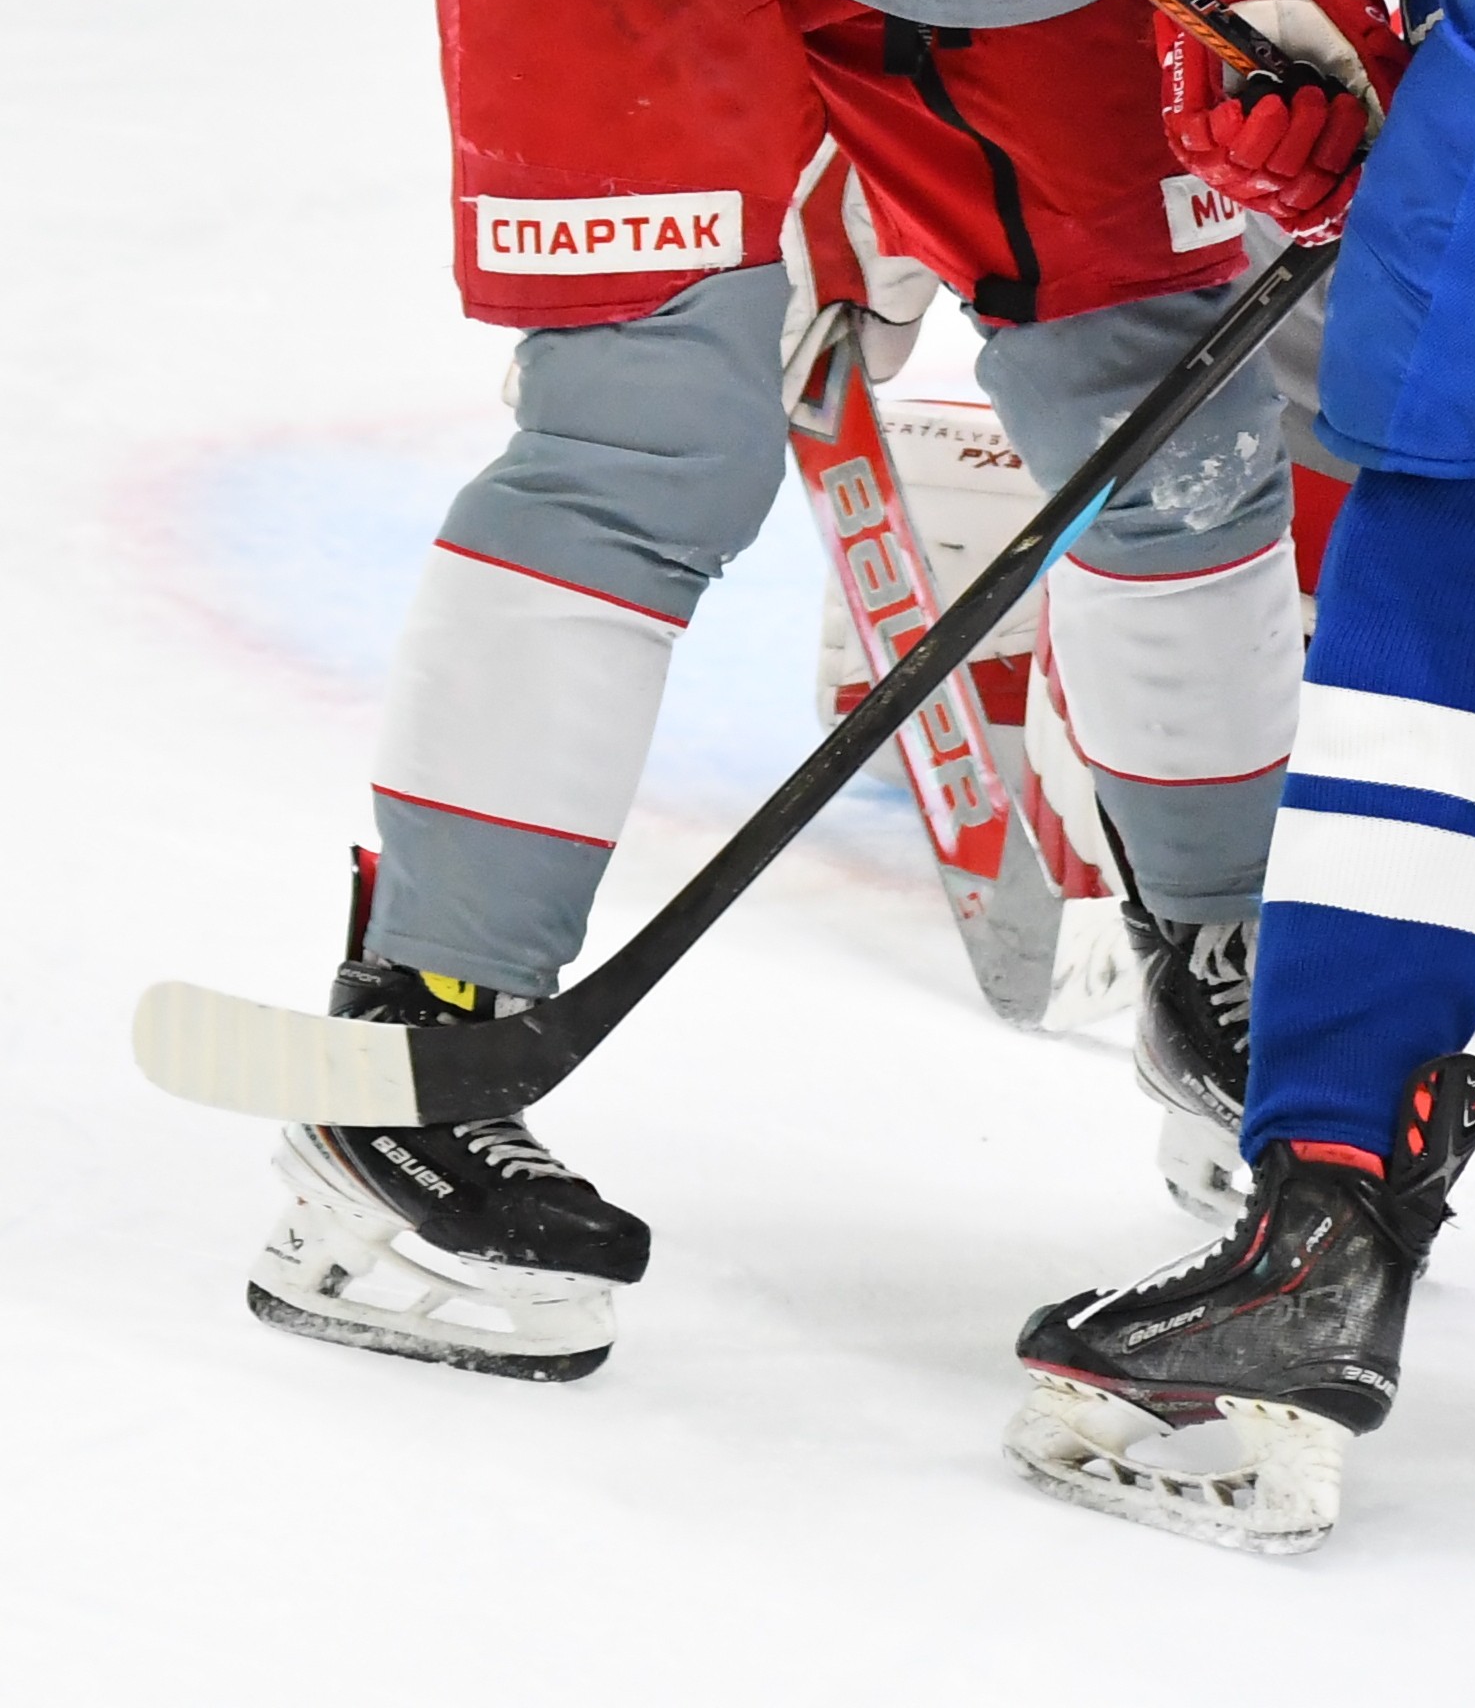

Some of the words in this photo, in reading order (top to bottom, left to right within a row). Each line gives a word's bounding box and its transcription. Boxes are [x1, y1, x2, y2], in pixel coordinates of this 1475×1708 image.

[490, 211, 723, 256] СПАРТАК
[882, 421, 1001, 446] CATALYS
[370, 1135, 455, 1199] BAUER
[1127, 1305, 1206, 1347] BAUER
